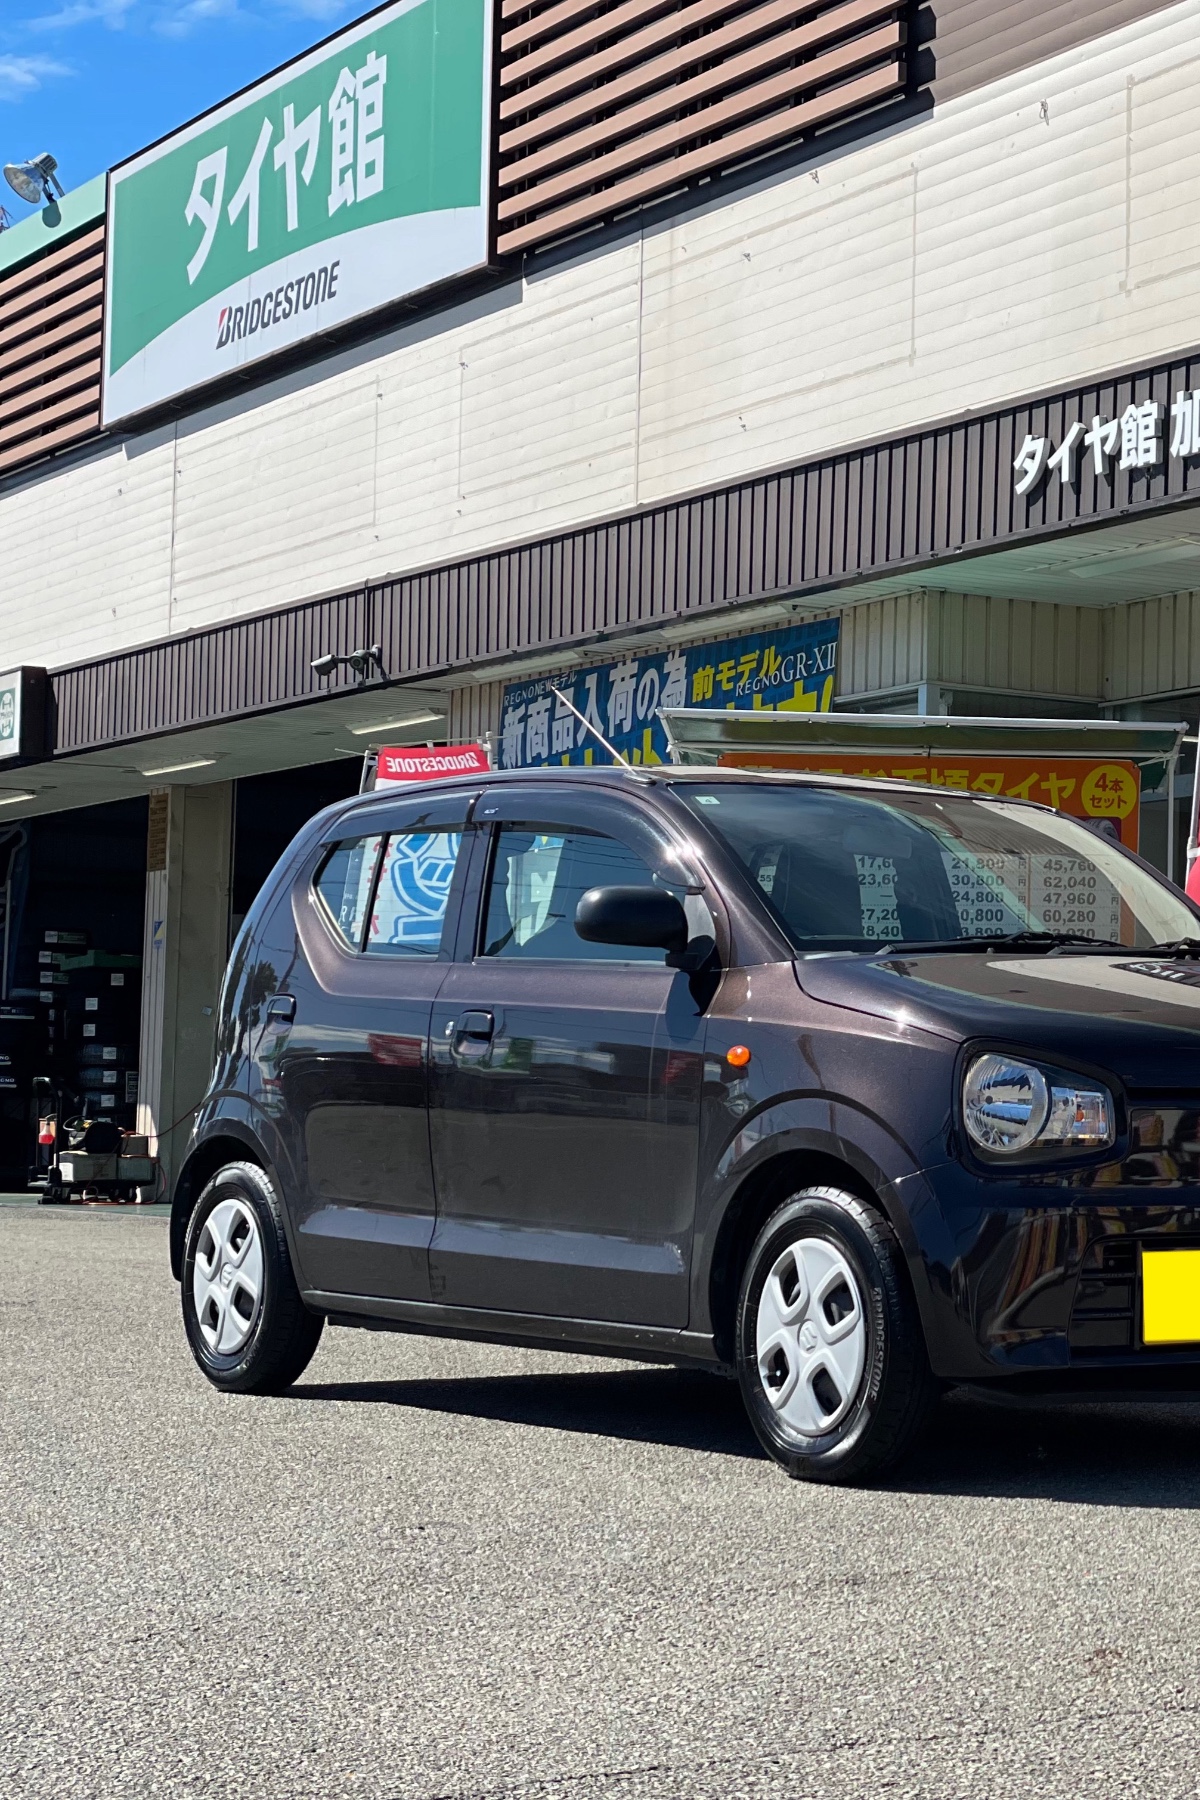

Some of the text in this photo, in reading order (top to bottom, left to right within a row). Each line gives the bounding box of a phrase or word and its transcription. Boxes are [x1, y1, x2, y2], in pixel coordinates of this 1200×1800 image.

[184, 51, 387, 285] タイヤ館
[216, 260, 340, 349] BRIDGESTONE
[1013, 400, 1163, 495] タイヤ館
[692, 645, 782, 703] 前モデル
[736, 670, 780, 697] REGNO
[1094, 772, 1124, 793] 4本
[1089, 794, 1127, 809] セット
[858, 855, 894, 870] 17,6
[1043, 858, 1097, 873] 45,760
[951, 874, 1005, 888] 30,800
[1043, 876, 1097, 890] 62,040
[953, 890, 1004, 906] 24,800
[1043, 892, 1097, 907] 47,960
[960, 908, 1004, 924] 0,800
[1043, 909, 1096, 925] 60,280
